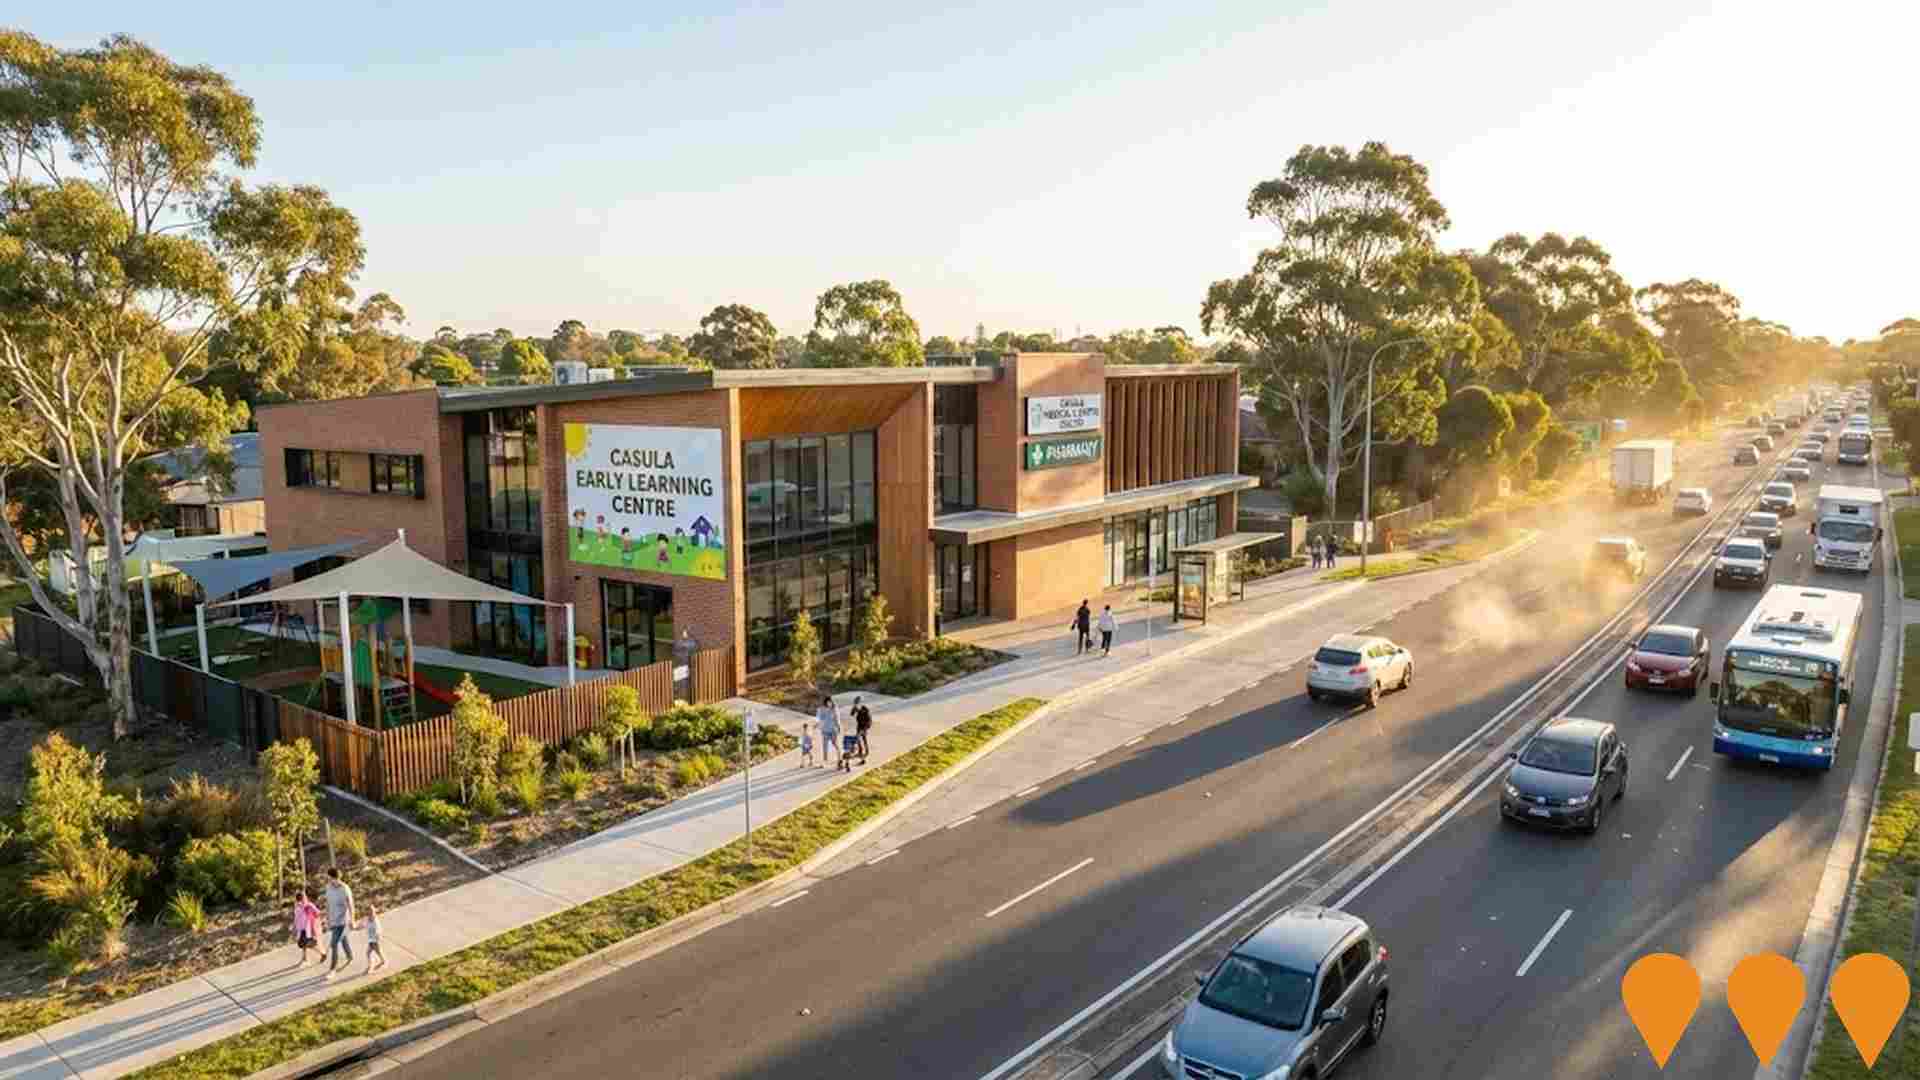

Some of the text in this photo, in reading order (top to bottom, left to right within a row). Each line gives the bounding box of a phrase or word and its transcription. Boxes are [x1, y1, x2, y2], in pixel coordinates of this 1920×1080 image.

[610, 449, 674, 469] CASULA
[576, 470, 713, 497] EARLY LEARNING
[612, 496, 676, 517] CENTRE
